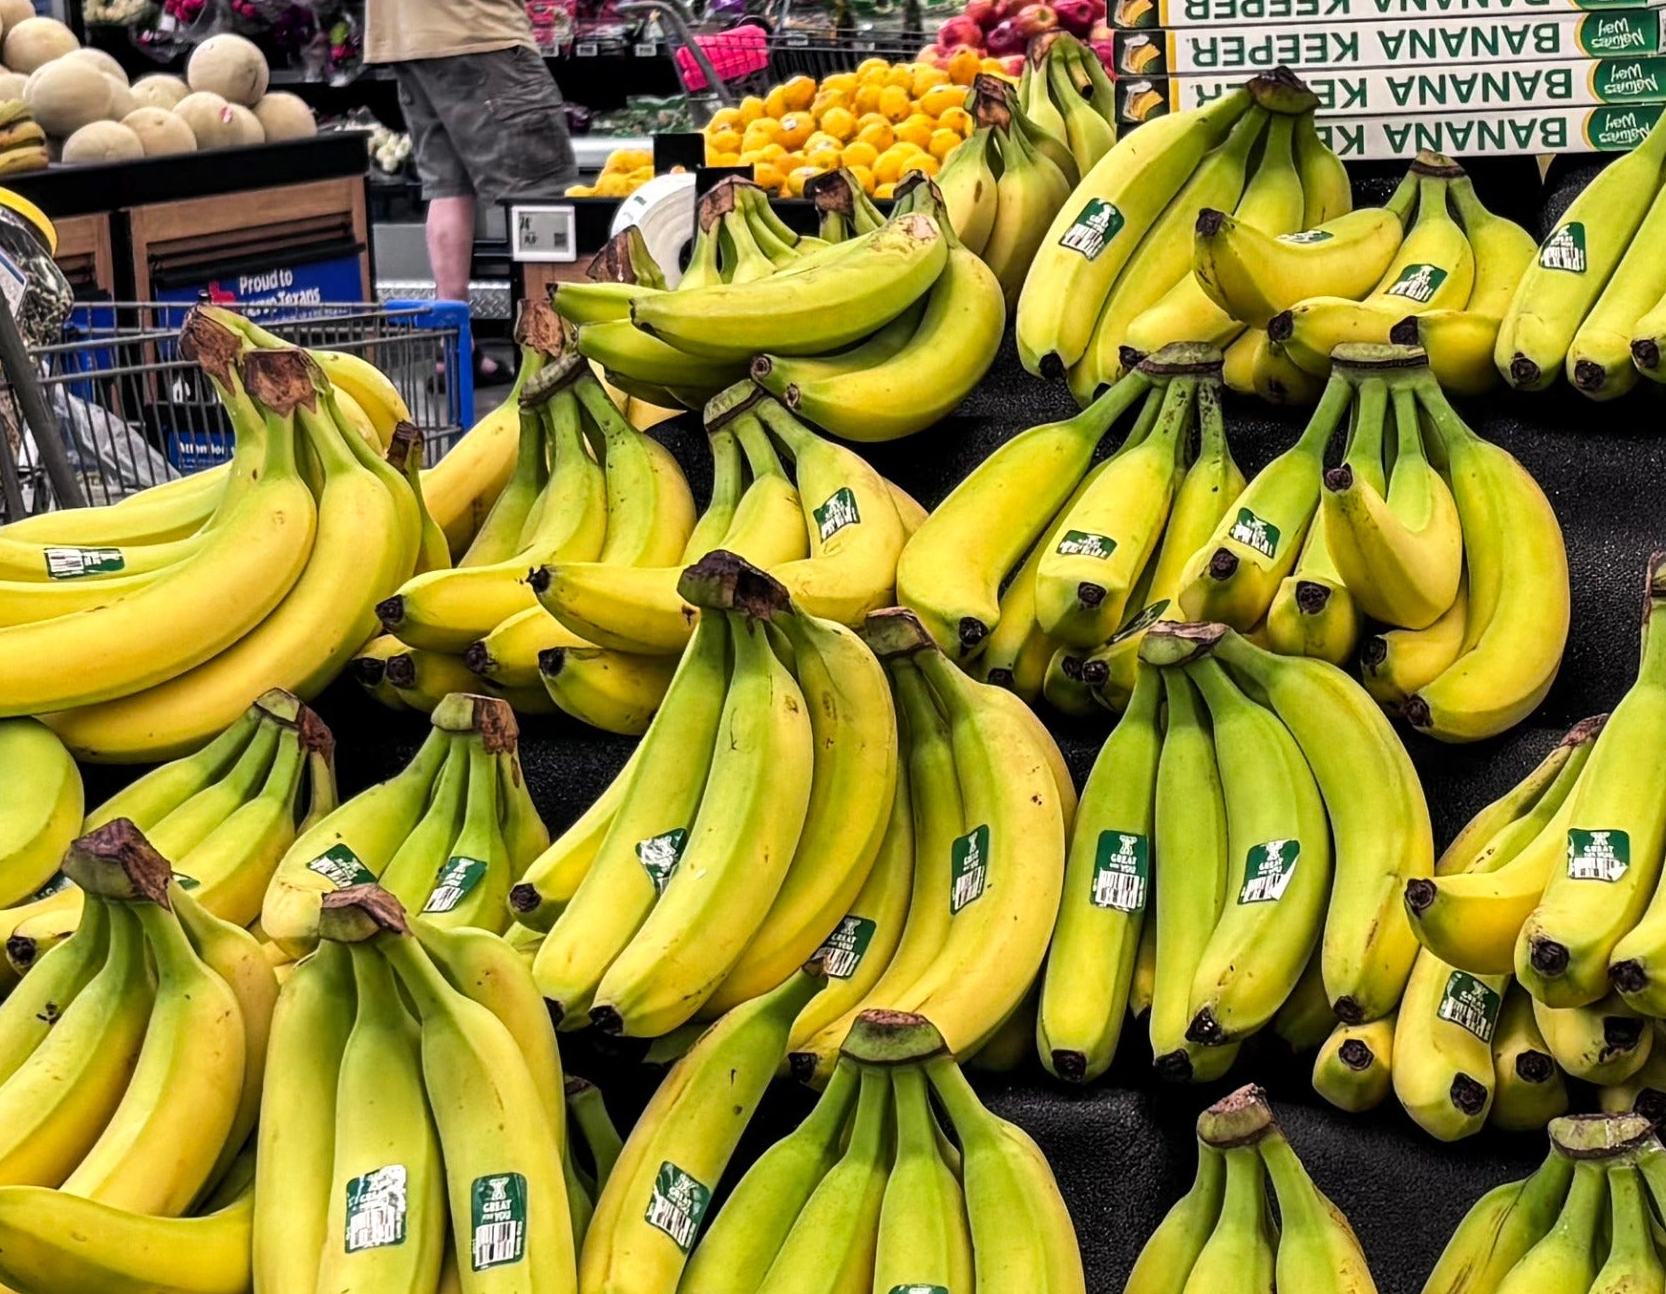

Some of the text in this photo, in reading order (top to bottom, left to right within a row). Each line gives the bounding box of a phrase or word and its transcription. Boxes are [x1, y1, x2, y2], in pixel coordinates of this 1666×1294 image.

[1192, 23, 1560, 66] BANANA KEEPER
[1386, 69, 1572, 107] BANANA
[1383, 117, 1567, 154] BANANA
[239, 269, 293, 295] Proud to
[1108, 853, 1135, 864] GREAT
[483, 1199, 512, 1212] GREAT
